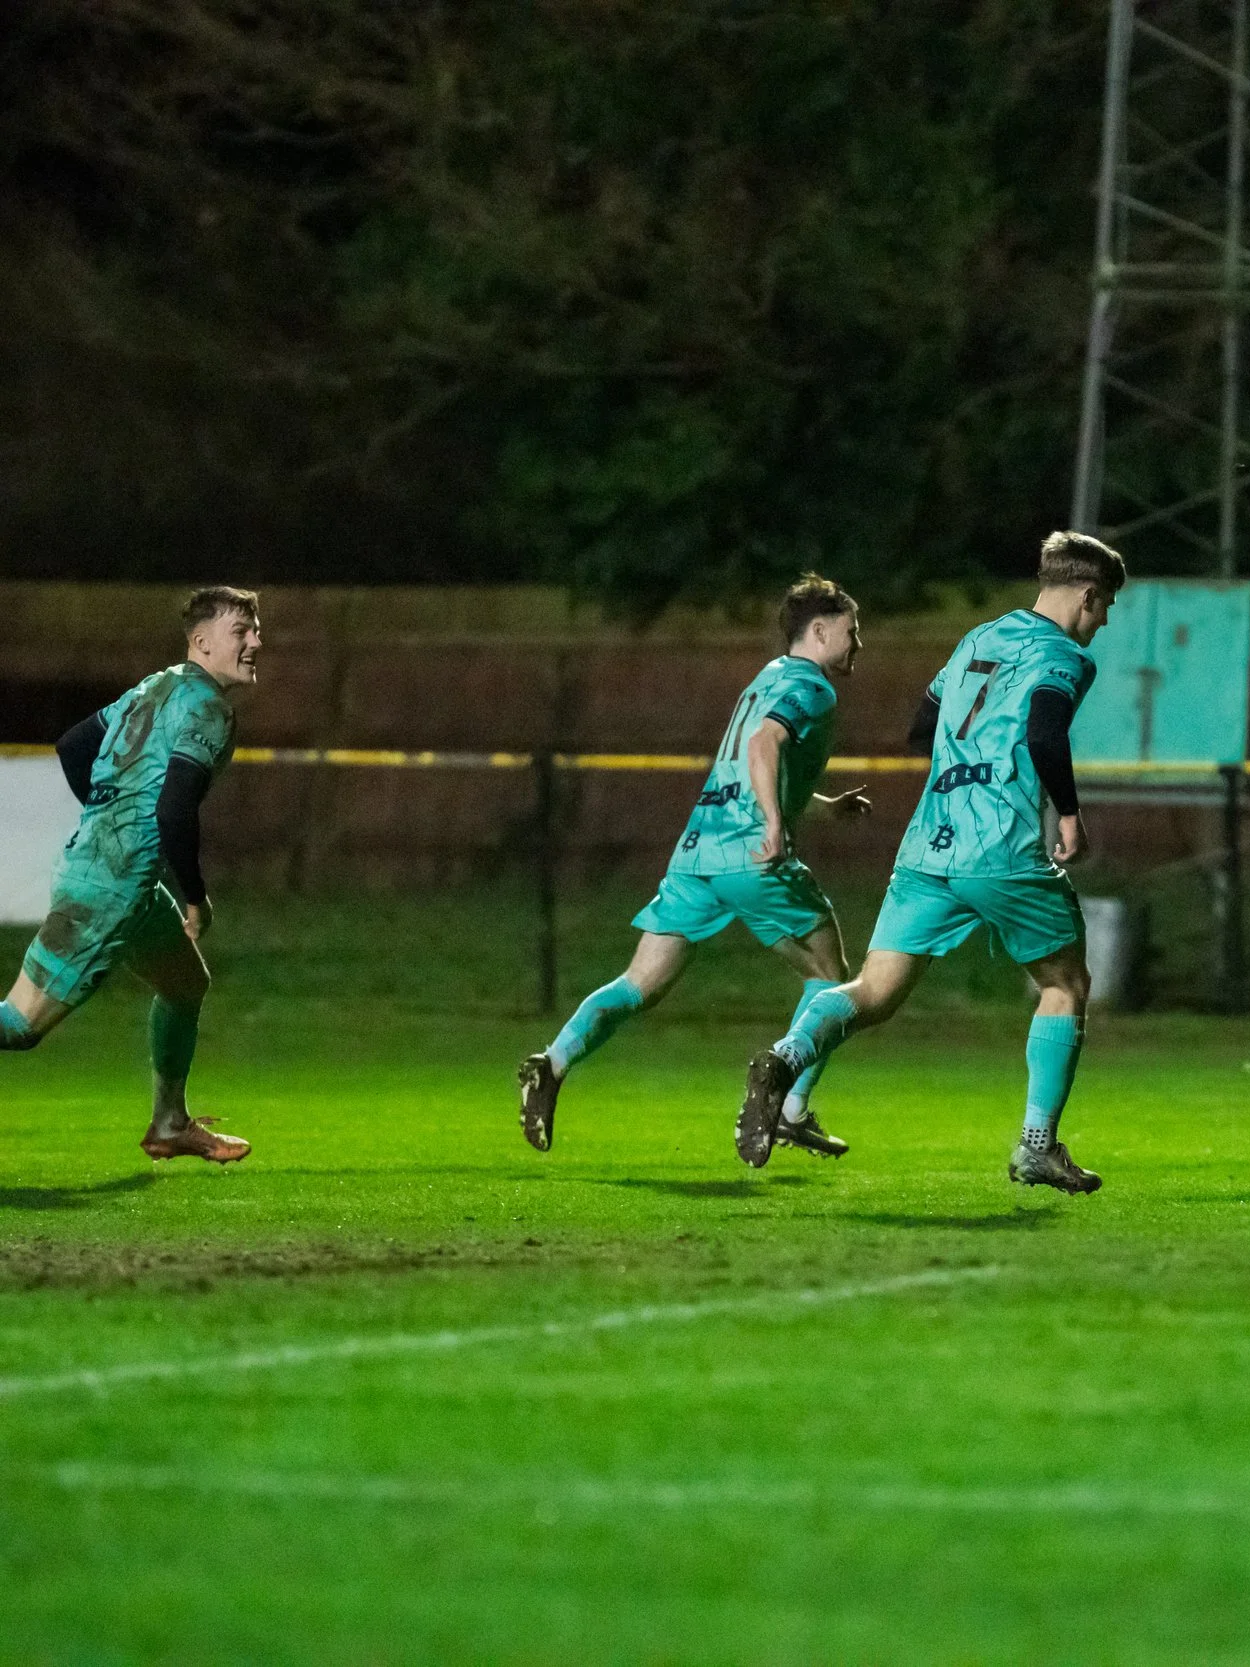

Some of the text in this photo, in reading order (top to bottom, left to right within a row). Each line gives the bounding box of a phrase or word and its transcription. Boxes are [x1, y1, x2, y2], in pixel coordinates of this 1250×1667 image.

[99, 695, 156, 768] 19
[719, 691, 757, 761] 11
[957, 659, 1001, 740] 7
[939, 767, 987, 790] IREN
